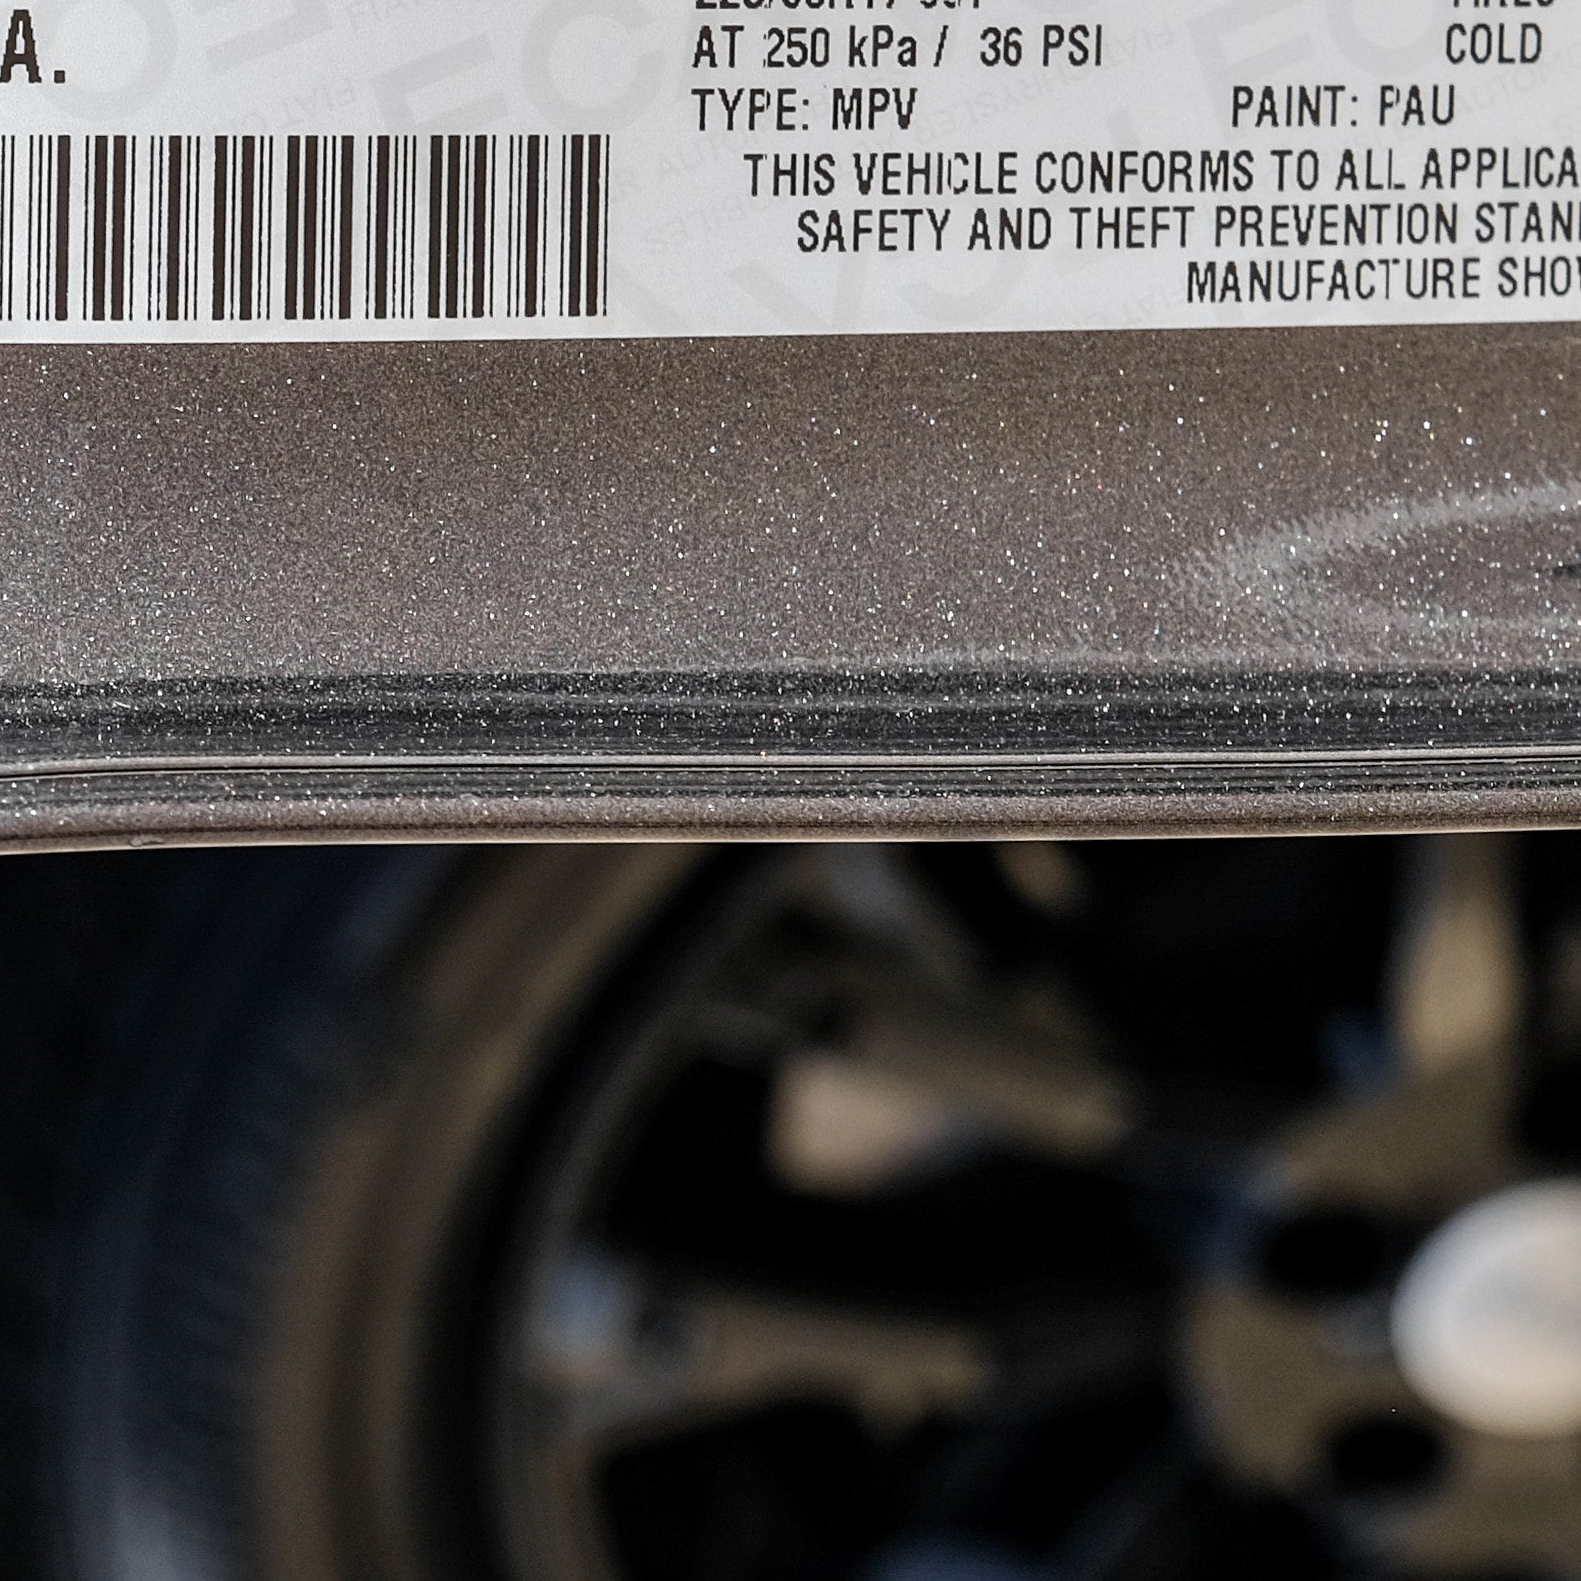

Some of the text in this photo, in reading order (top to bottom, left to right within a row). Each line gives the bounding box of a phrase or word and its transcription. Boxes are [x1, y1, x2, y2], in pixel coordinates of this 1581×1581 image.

[692, 25, 744, 68] AT
[768, 28, 829, 67] 250
[849, 25, 916, 67] kPa
[981, 27, 1022, 66] 36
[1043, 25, 1101, 66] PSI
[1447, 23, 1541, 64] COLD
[691, 88, 917, 131] TYPE: MPV
[1232, 85, 1454, 127] PAINT: PAU
[744, 154, 835, 196] THIS
[853, 152, 1017, 195] VEHICLE
[1036, 150, 1253, 193] CONFORMS
[1271, 150, 1318, 191] TO
[1336, 149, 1405, 190] ALL
[798, 209, 950, 252] SAFETY
[968, 208, 1051, 250] AND
[1070, 206, 1194, 249] THEFT
[1216, 203, 1457, 247] PREVENTION
[1188, 258, 1480, 303] MANUFACTURE
